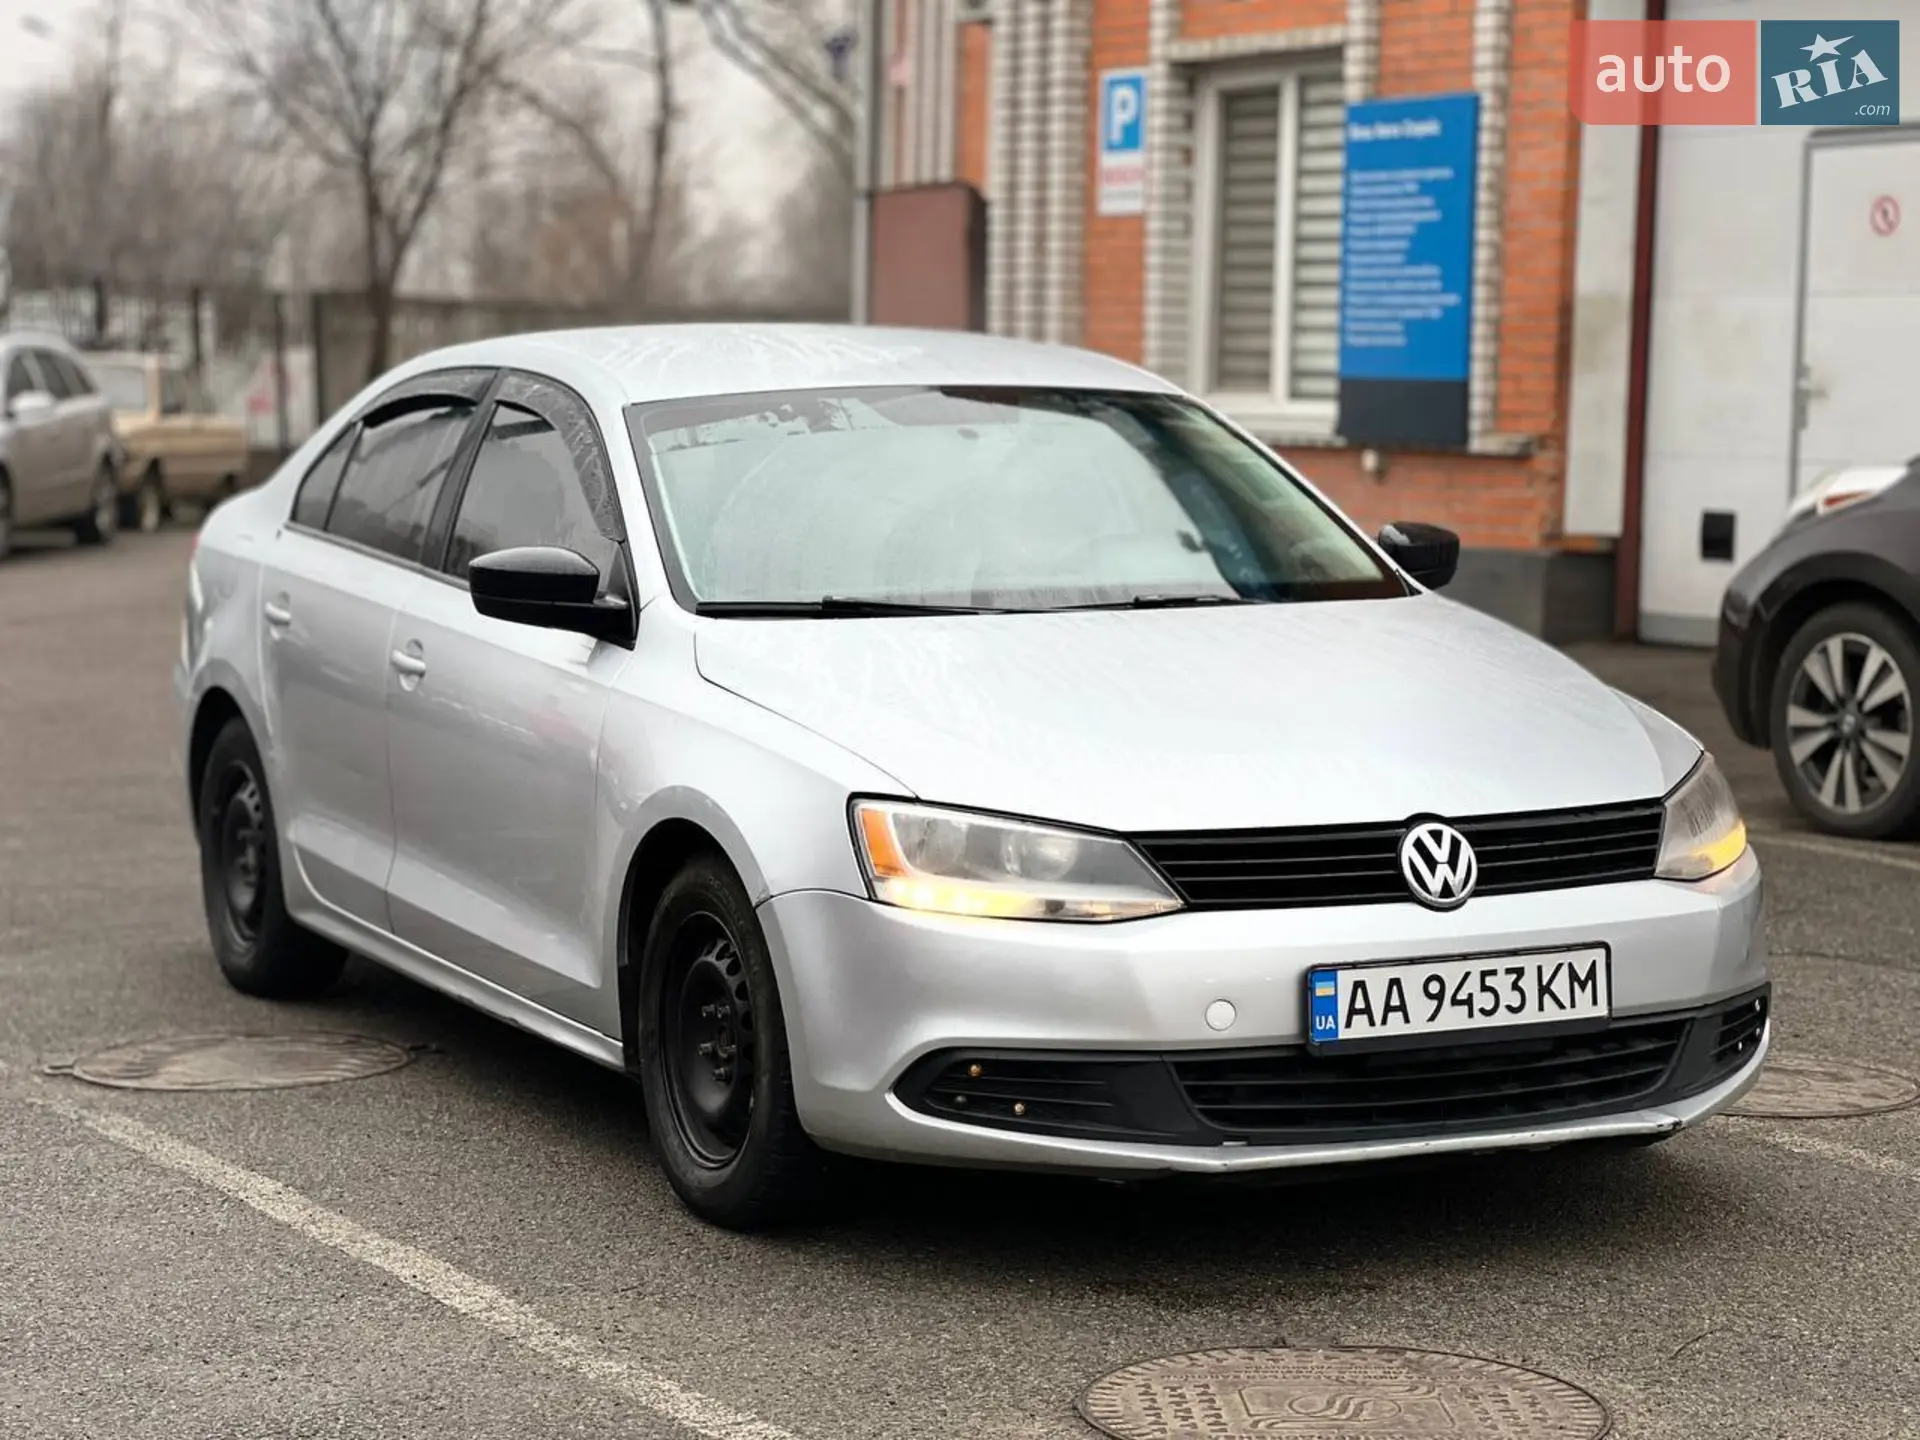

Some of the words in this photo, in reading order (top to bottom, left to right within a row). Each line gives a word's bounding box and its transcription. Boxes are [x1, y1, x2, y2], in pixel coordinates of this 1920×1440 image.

[1110, 84, 1139, 146] P
[1401, 822, 1478, 903] VW
[1315, 1014, 1336, 1031] UA
[1344, 977, 1411, 1029] AA
[1422, 966, 1527, 1023] 9453
[1536, 959, 1599, 1013] KM
